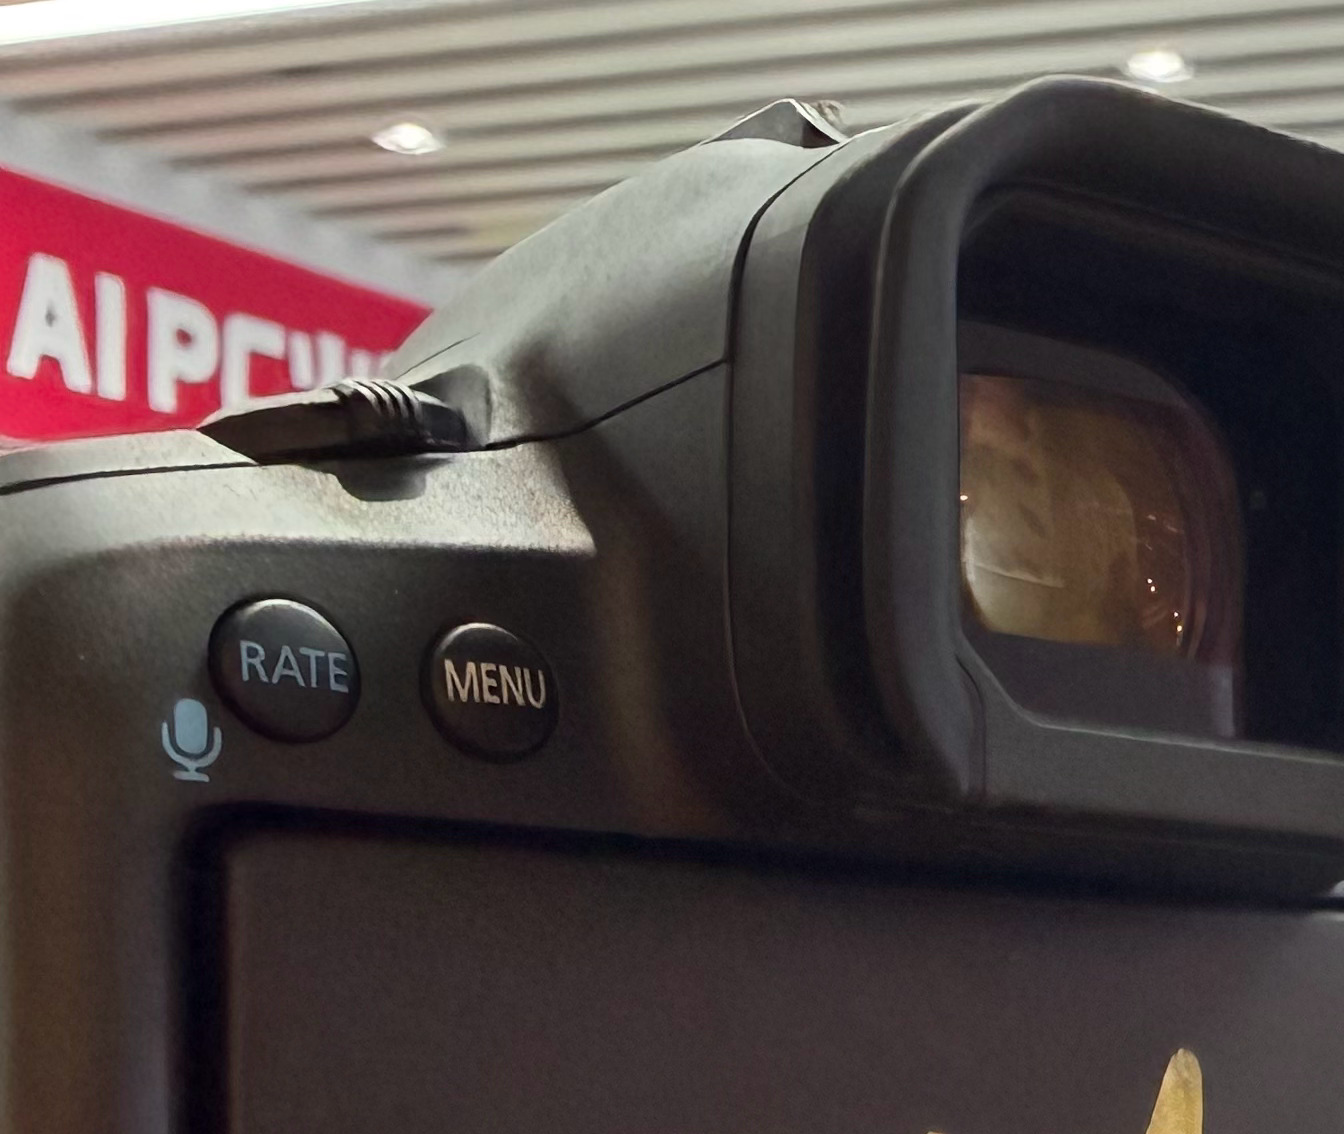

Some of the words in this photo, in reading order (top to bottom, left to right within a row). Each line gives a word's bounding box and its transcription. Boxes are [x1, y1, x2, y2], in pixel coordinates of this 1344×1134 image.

[7, 251, 126, 401] AI
[239, 639, 350, 695] RATE
[443, 656, 547, 710] MENU
